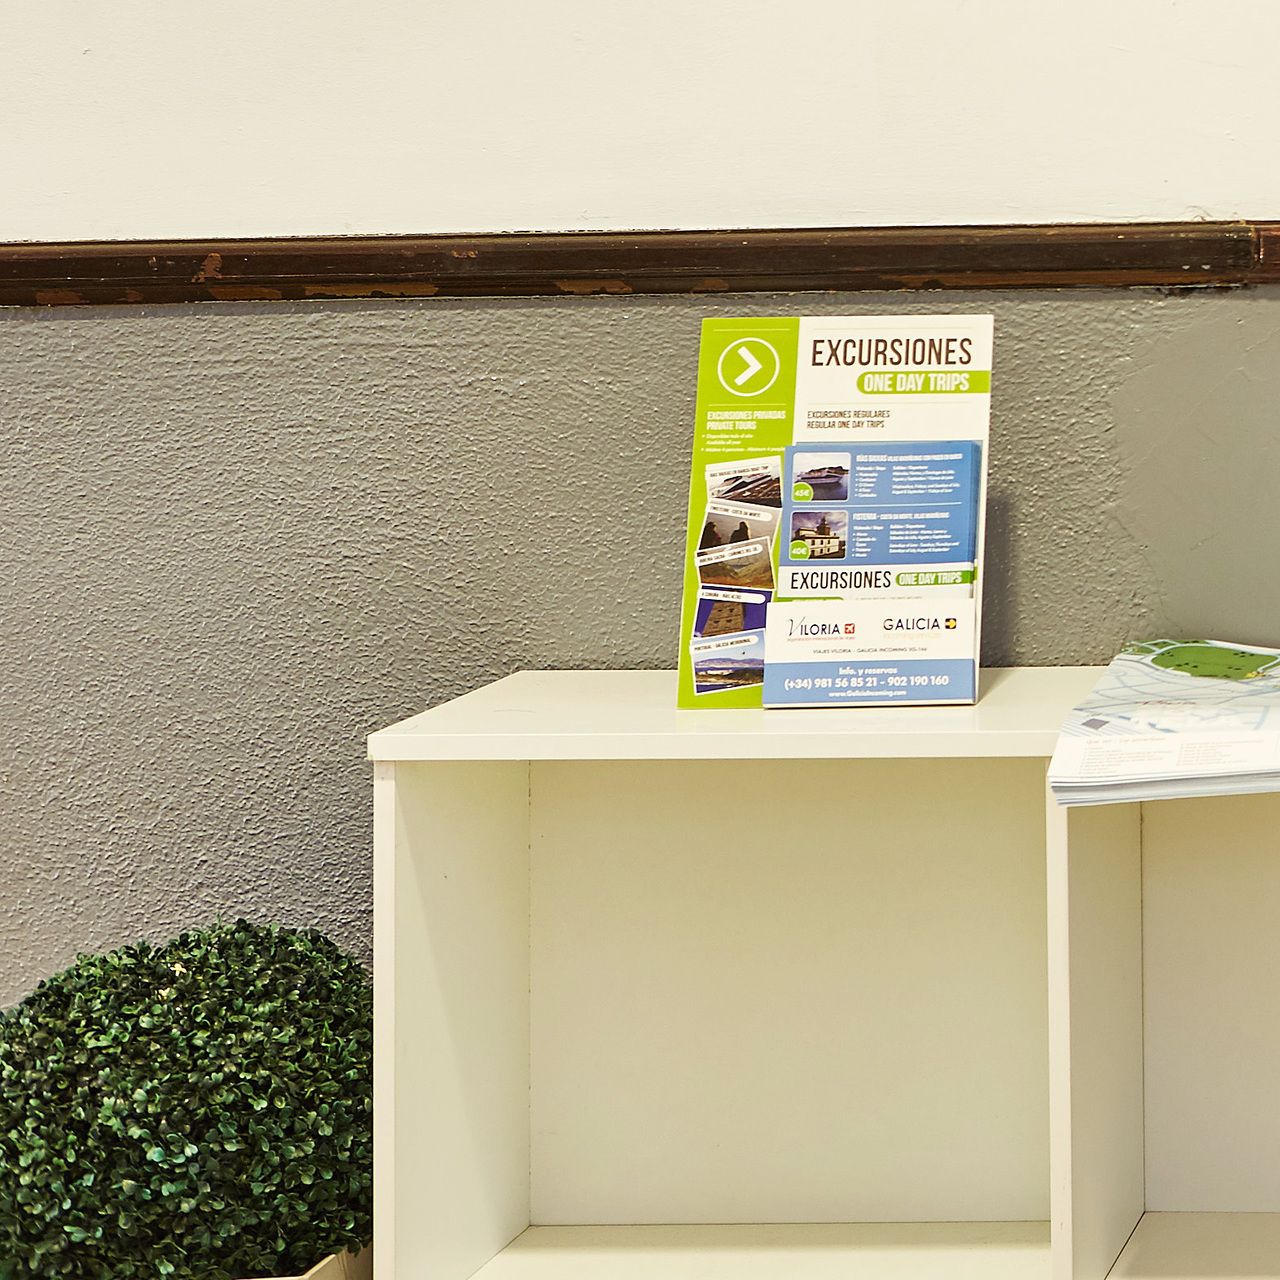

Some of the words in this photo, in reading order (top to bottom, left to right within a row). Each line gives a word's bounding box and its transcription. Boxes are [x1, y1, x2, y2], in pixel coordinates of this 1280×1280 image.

[811, 338, 972, 367] EXCURSIONES
[864, 372, 894, 393] ONE
[896, 372, 925, 392] DAY
[929, 371, 969, 391] TRIPS
[807, 411, 851, 419] EXCURSIONES
[853, 410, 890, 418] REGULARES
[807, 420, 836, 429] REGULAR
[837, 420, 849, 428] ONE
[851, 420, 864, 428] DAY
[866, 420, 884, 428] TRIPS
[791, 571, 891, 589] EXCURSIONES
[899, 573, 917, 585] ONE
[918, 573, 935, 584] DAY
[937, 572, 962, 584] TRIPS
[789, 617, 840, 636] VILORIA
[884, 618, 940, 630] GALICIA
[839, 667, 855, 675] Info.
[784, 679, 812, 690] (+34)
[814, 679, 832, 688] 981
[835, 678, 849, 688] 56
[850, 678, 864, 687] 85
[866, 677, 877, 686] 21
[888, 677, 908, 686] 902
[910, 676, 928, 685] 190
[930, 675, 949, 685] 160
